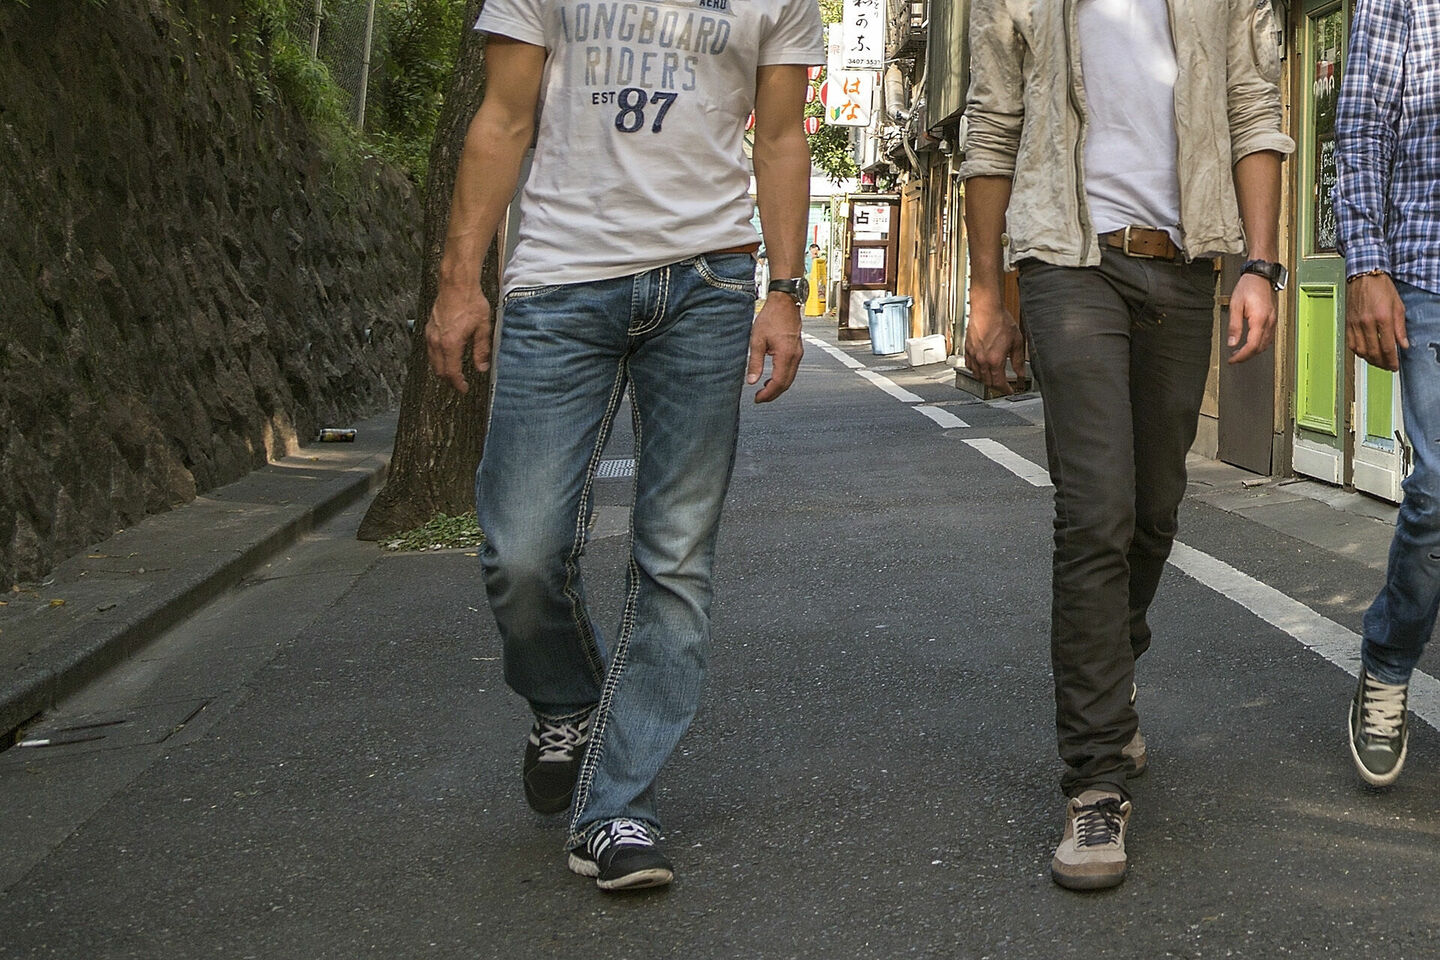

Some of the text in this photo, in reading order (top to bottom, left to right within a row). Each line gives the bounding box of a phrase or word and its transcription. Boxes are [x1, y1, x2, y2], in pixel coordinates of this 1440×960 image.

[560, 2, 731, 56] LONGBOARD
[584, 46, 699, 92] RIDERS
[591, 87, 678, 134] EST 87
[841, 77, 860, 121] はな
